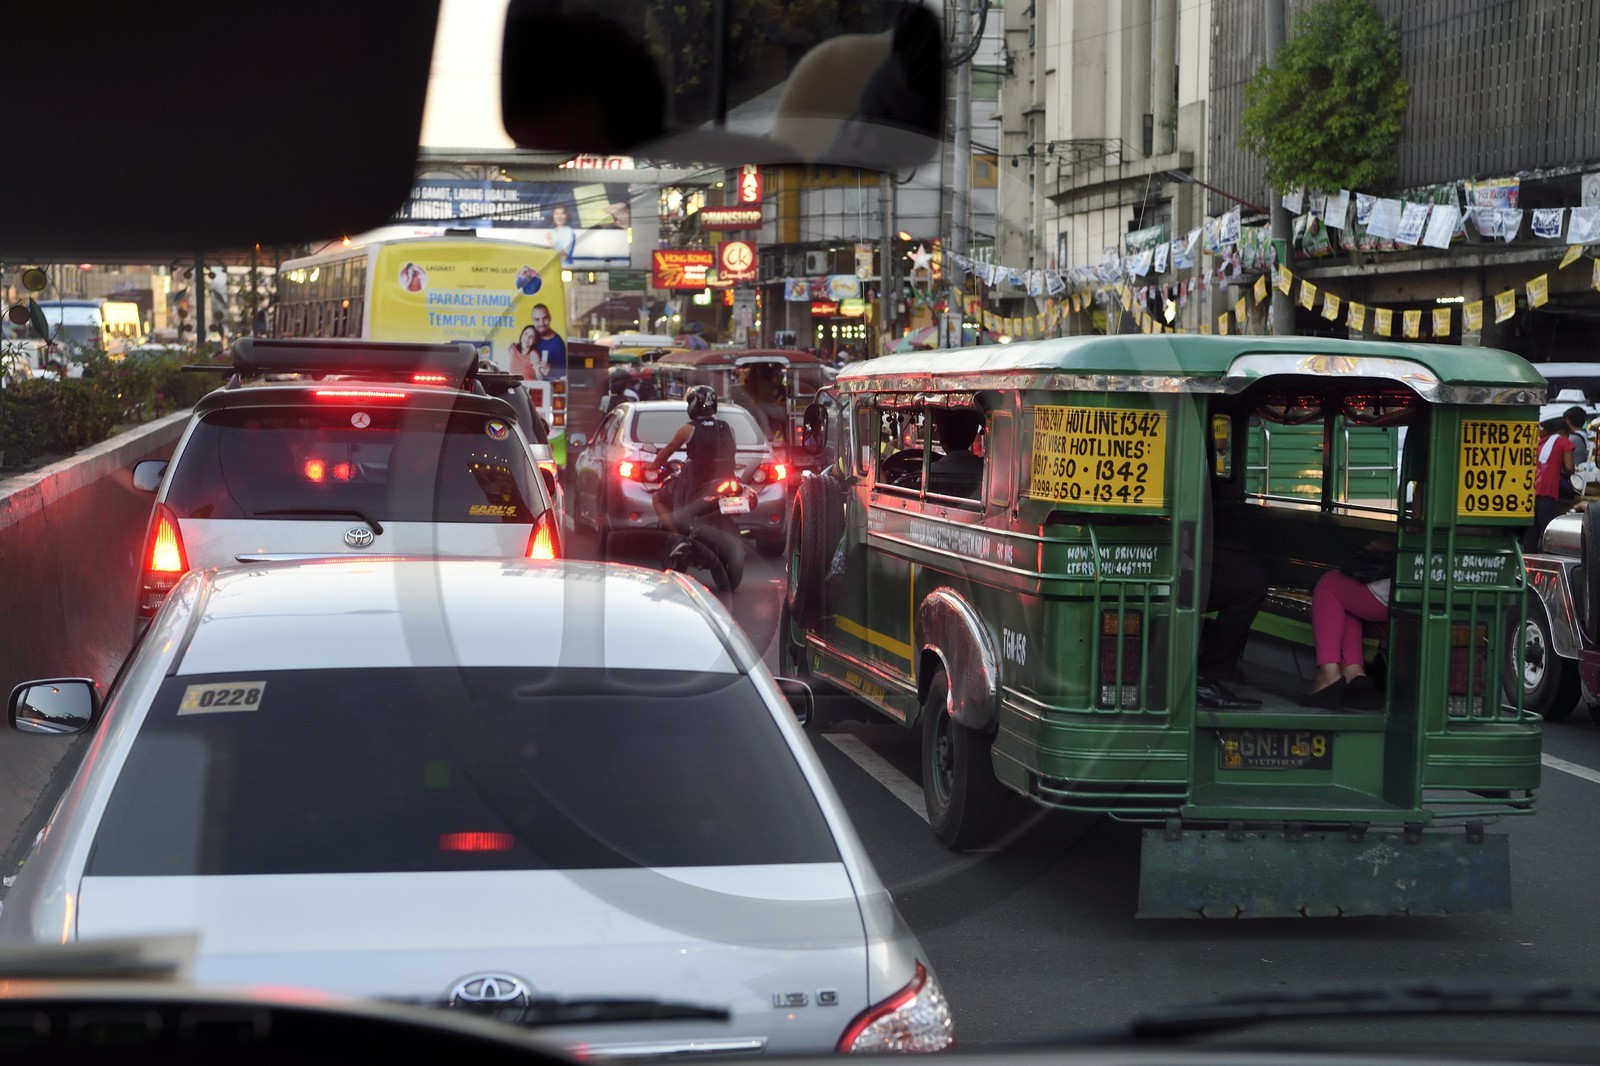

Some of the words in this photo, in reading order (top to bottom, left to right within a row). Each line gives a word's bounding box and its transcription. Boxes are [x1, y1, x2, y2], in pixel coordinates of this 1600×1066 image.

[701, 211, 761, 225] PAWNSHOP
[429, 293, 513, 308] PARACETAMOL
[428, 312, 477, 327] TEMPRA
[482, 315, 515, 329] FORTE
[1120, 412, 1160, 437] 1342
[1463, 423, 1510, 444] LTFRB
[1070, 438, 1151, 459] HOTLINES:
[469, 504, 517, 515] EARL'S
[1115, 546, 1158, 561] DRIVING?
[1462, 555, 1506, 570] DRIVING?
[199, 688, 260, 707] 0228
[815, 988, 839, 1007] G
